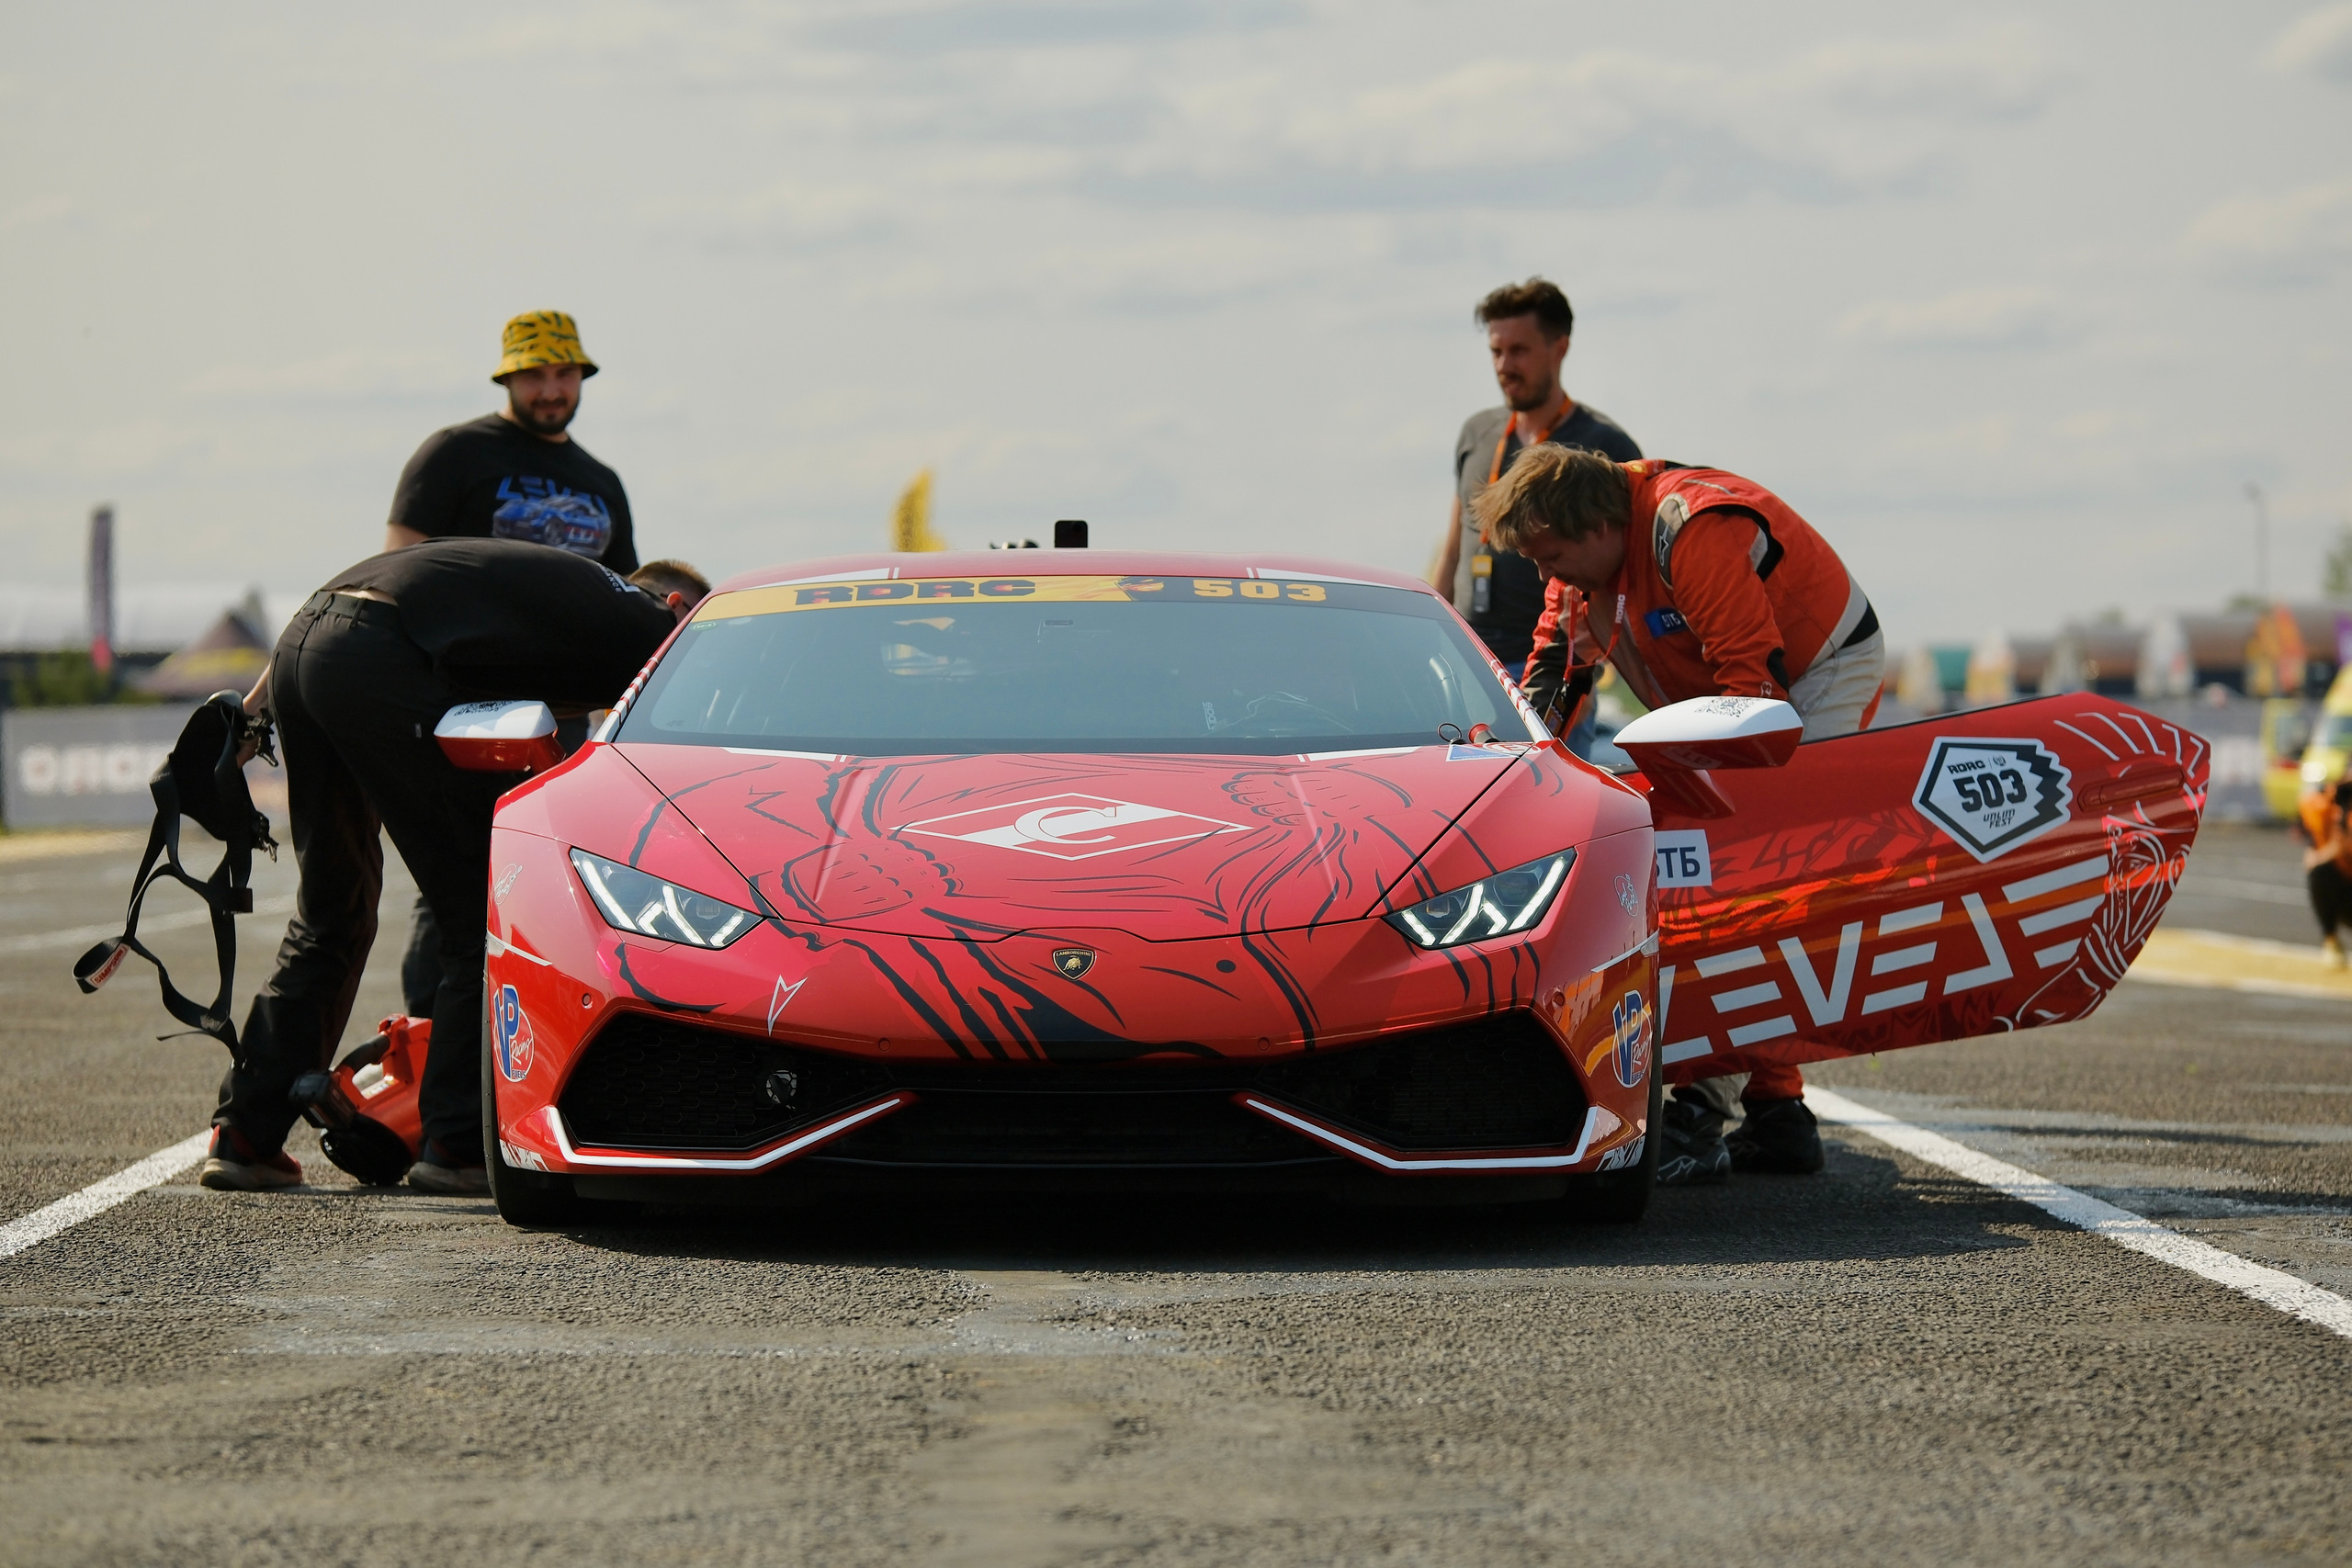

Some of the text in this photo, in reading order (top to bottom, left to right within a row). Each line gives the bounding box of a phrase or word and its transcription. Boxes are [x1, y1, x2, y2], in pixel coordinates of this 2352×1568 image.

[794, 580, 1327, 605] RDRC 503
[1953, 769, 2027, 813] 503
[1984, 808, 2016, 822] UNLIM
[1989, 818, 2013, 829] FEST
[1657, 847, 1701, 878] ТБ
[94, 949, 123, 984] SIMPSON
[493, 984, 519, 1078] VP
[1612, 990, 1643, 1086] VP
[511, 1036, 533, 1067] Racing
[512, 1069, 526, 1079] FUELS
